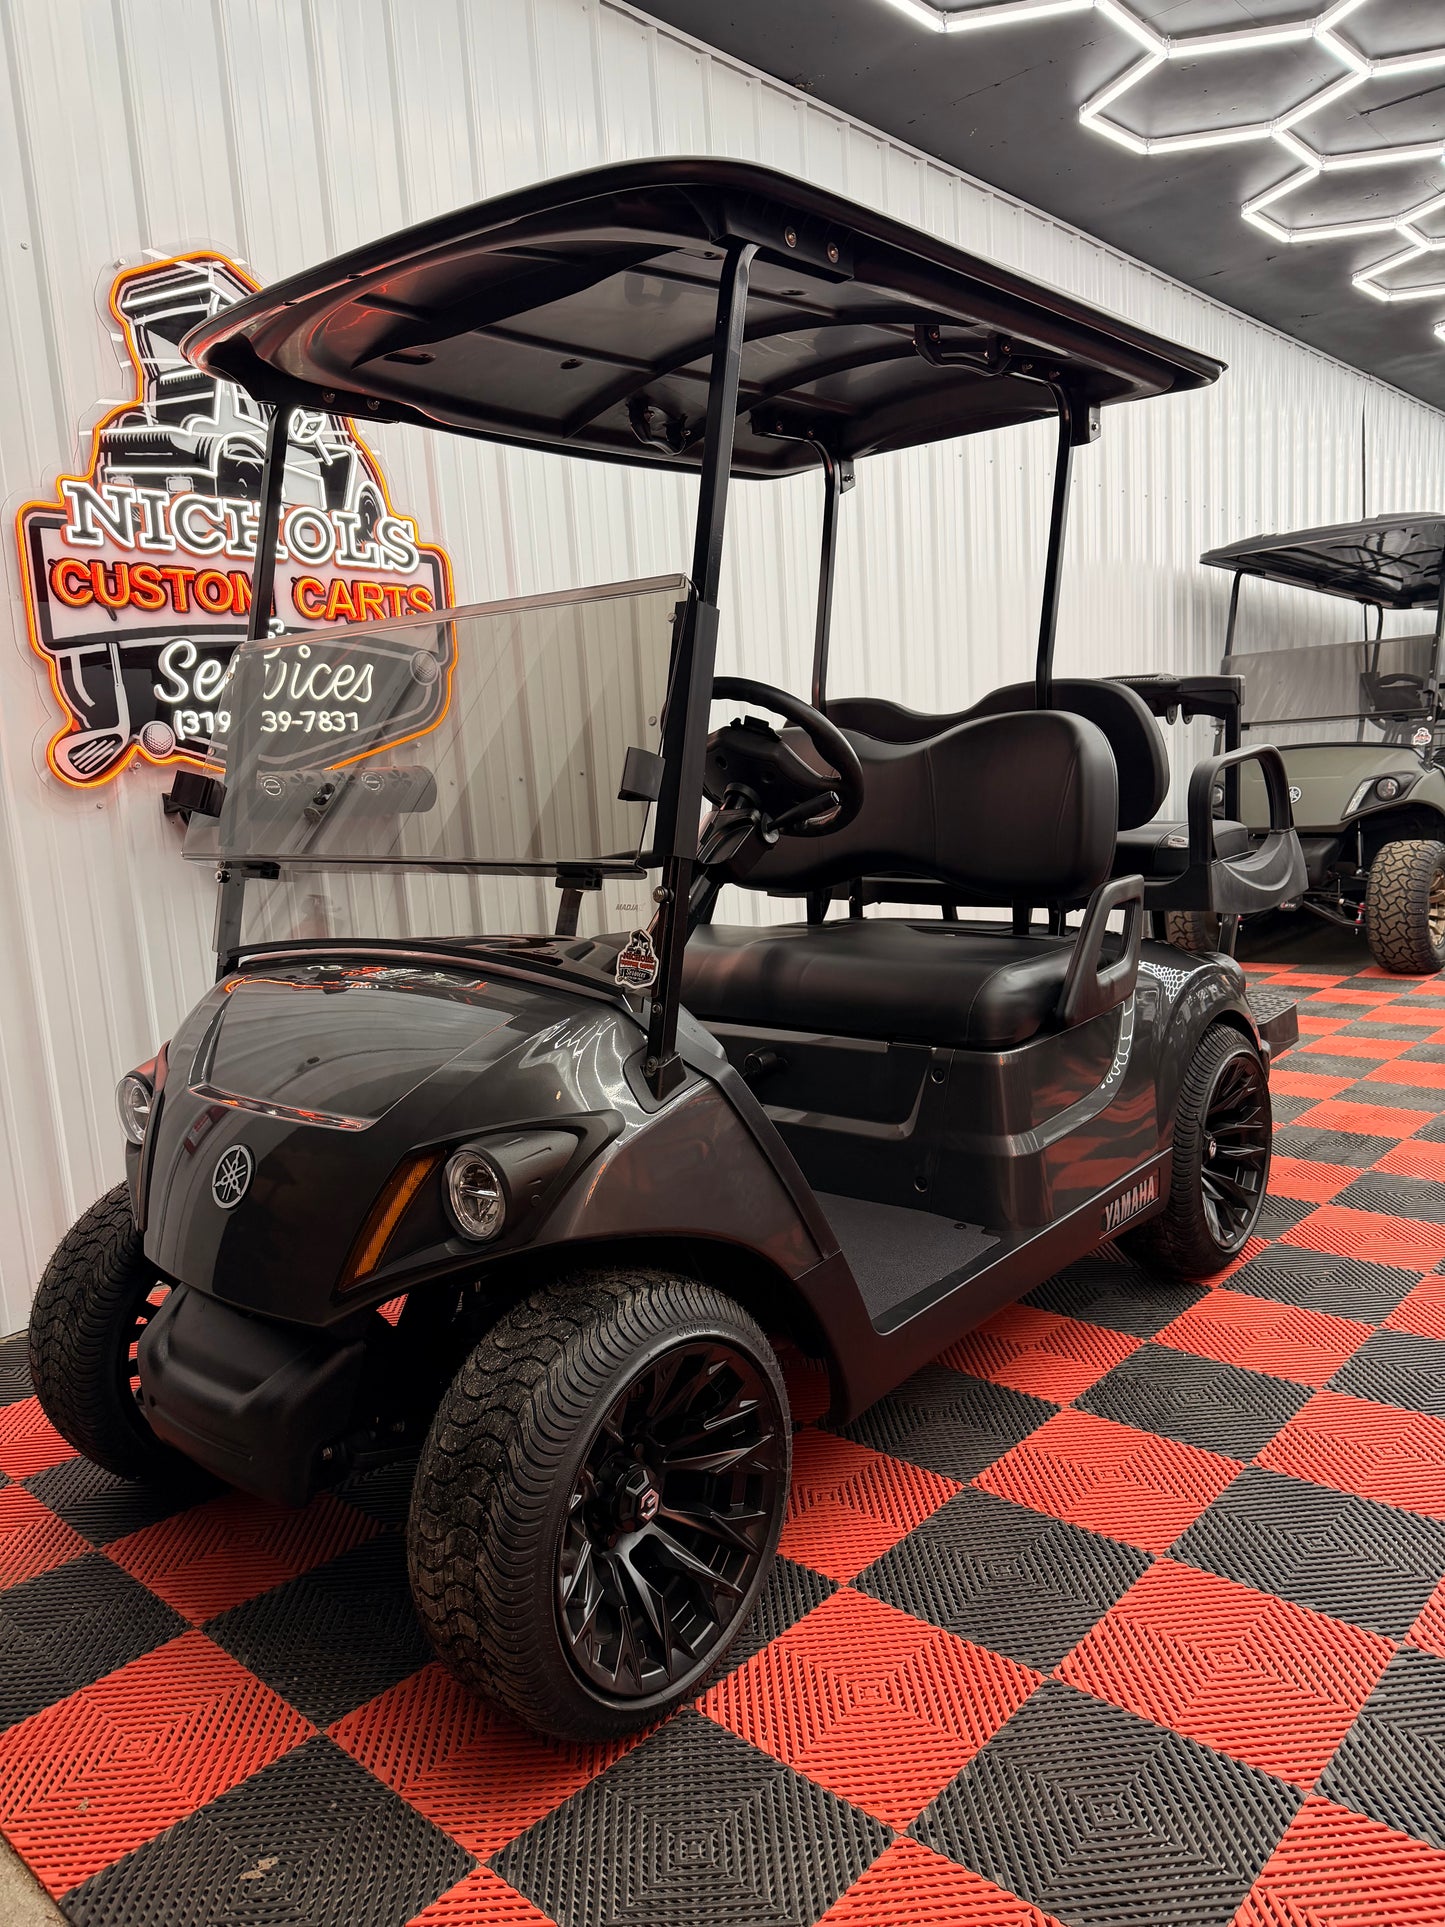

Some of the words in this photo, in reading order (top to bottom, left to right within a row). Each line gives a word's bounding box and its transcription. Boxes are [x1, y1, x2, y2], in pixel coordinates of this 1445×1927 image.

[62, 480, 420, 575] NICHOLS
[292, 576, 435, 622] CARTS
[153, 638, 374, 703] Sevices
[173, 709, 234, 741] (319
[259, 709, 359, 734] 39-7831
[1104, 1175, 1155, 1232] YAMAHA
